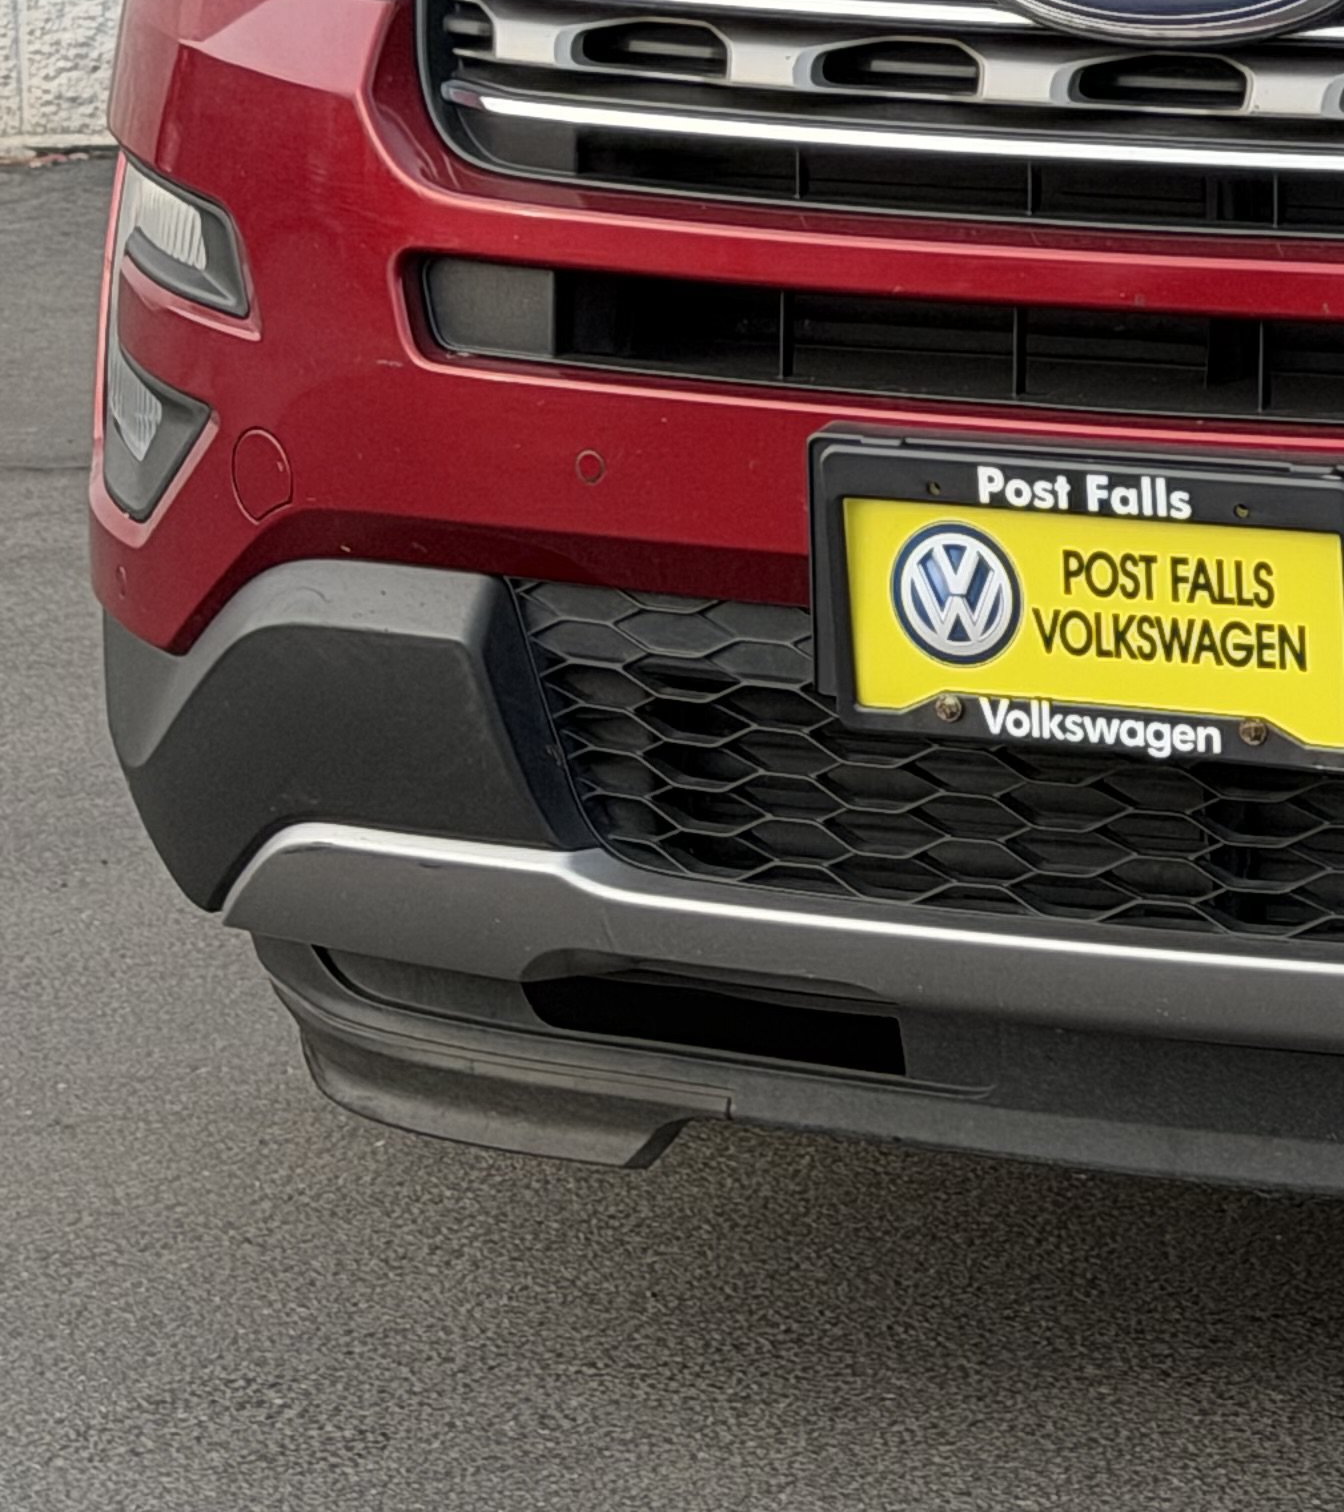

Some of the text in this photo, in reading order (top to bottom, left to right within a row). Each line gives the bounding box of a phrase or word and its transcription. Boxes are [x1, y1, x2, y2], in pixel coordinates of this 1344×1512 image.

[976, 465, 1193, 520] Post Falls
[1062, 549, 1275, 609] POST FALLS
[1032, 608, 1307, 672] VOLKSWAGEN
[977, 697, 1222, 759] Volkswagen
